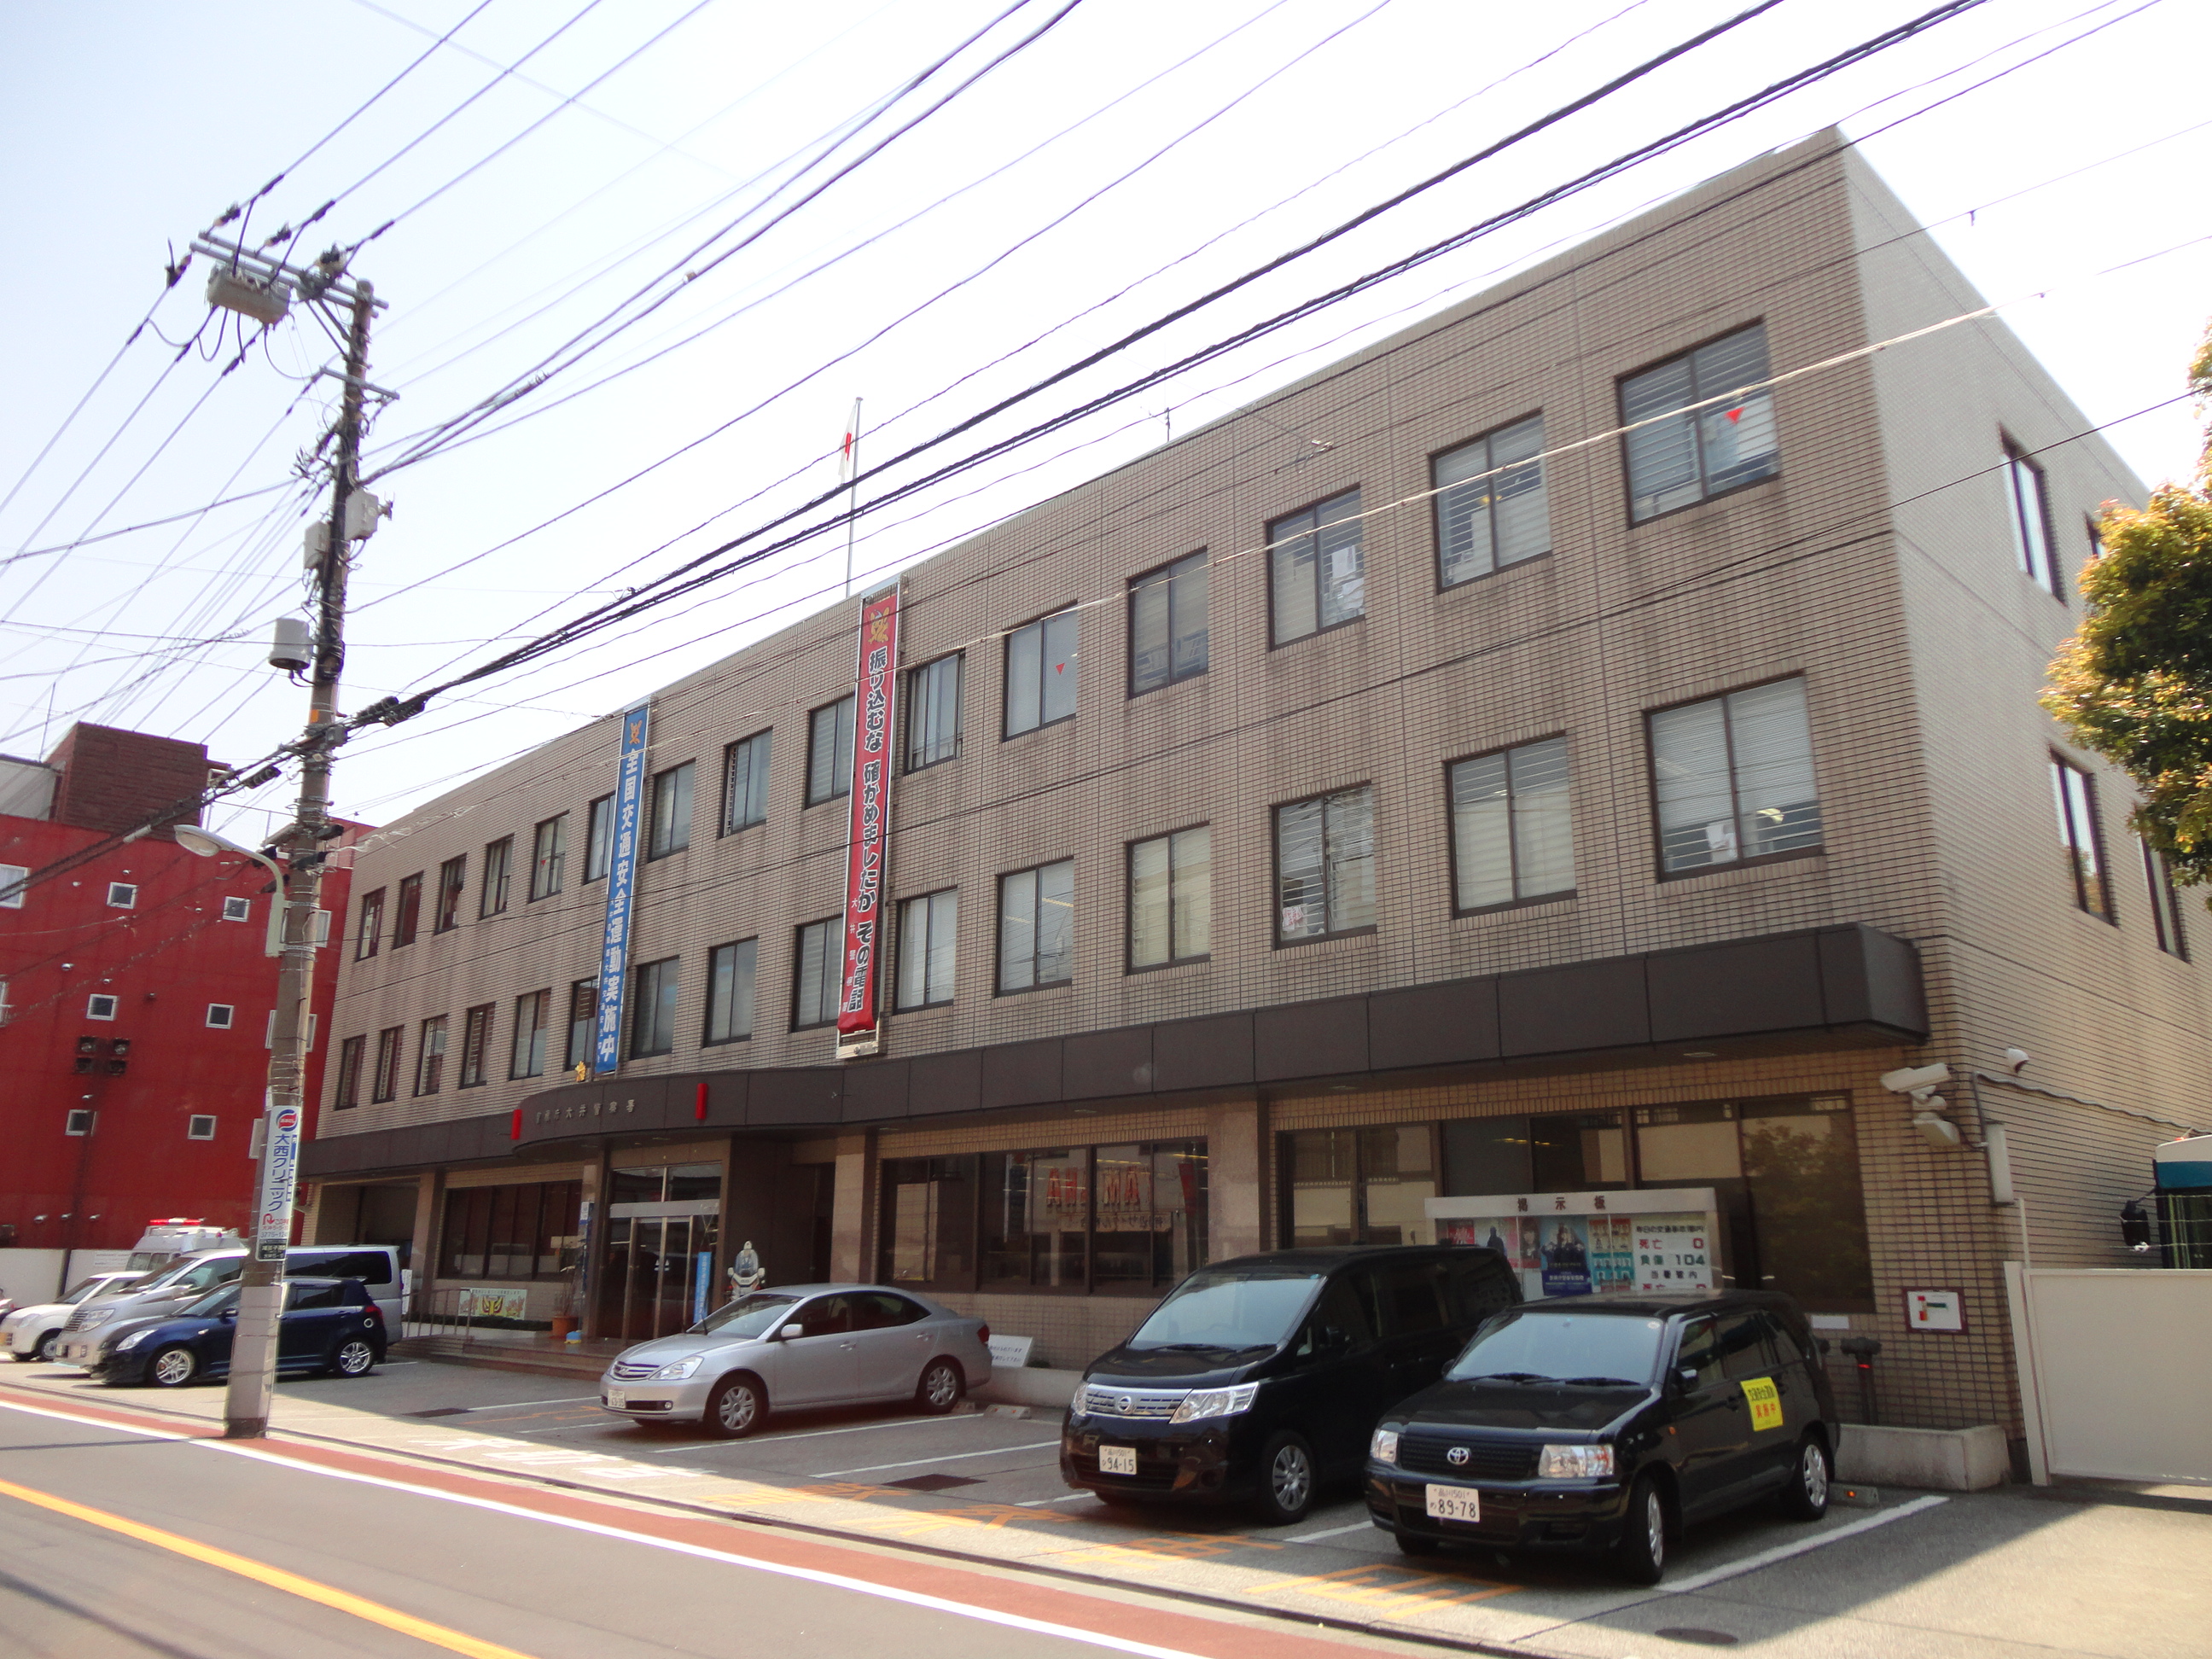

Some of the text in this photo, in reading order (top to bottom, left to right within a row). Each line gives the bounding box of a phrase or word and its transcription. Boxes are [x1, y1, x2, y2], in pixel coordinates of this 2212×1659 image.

[848, 647, 887, 1013] 振り込むな 確かめましたか その電話
[600, 748, 639, 1062] 全国交通安全運動実施中
[268, 1133, 290, 1212] 大西クリニック
[1517, 1195, 1606, 1212] 掲示板
[1107, 1457, 1134, 1472] 94-15
[1438, 1499, 1476, 1518] 89-78
